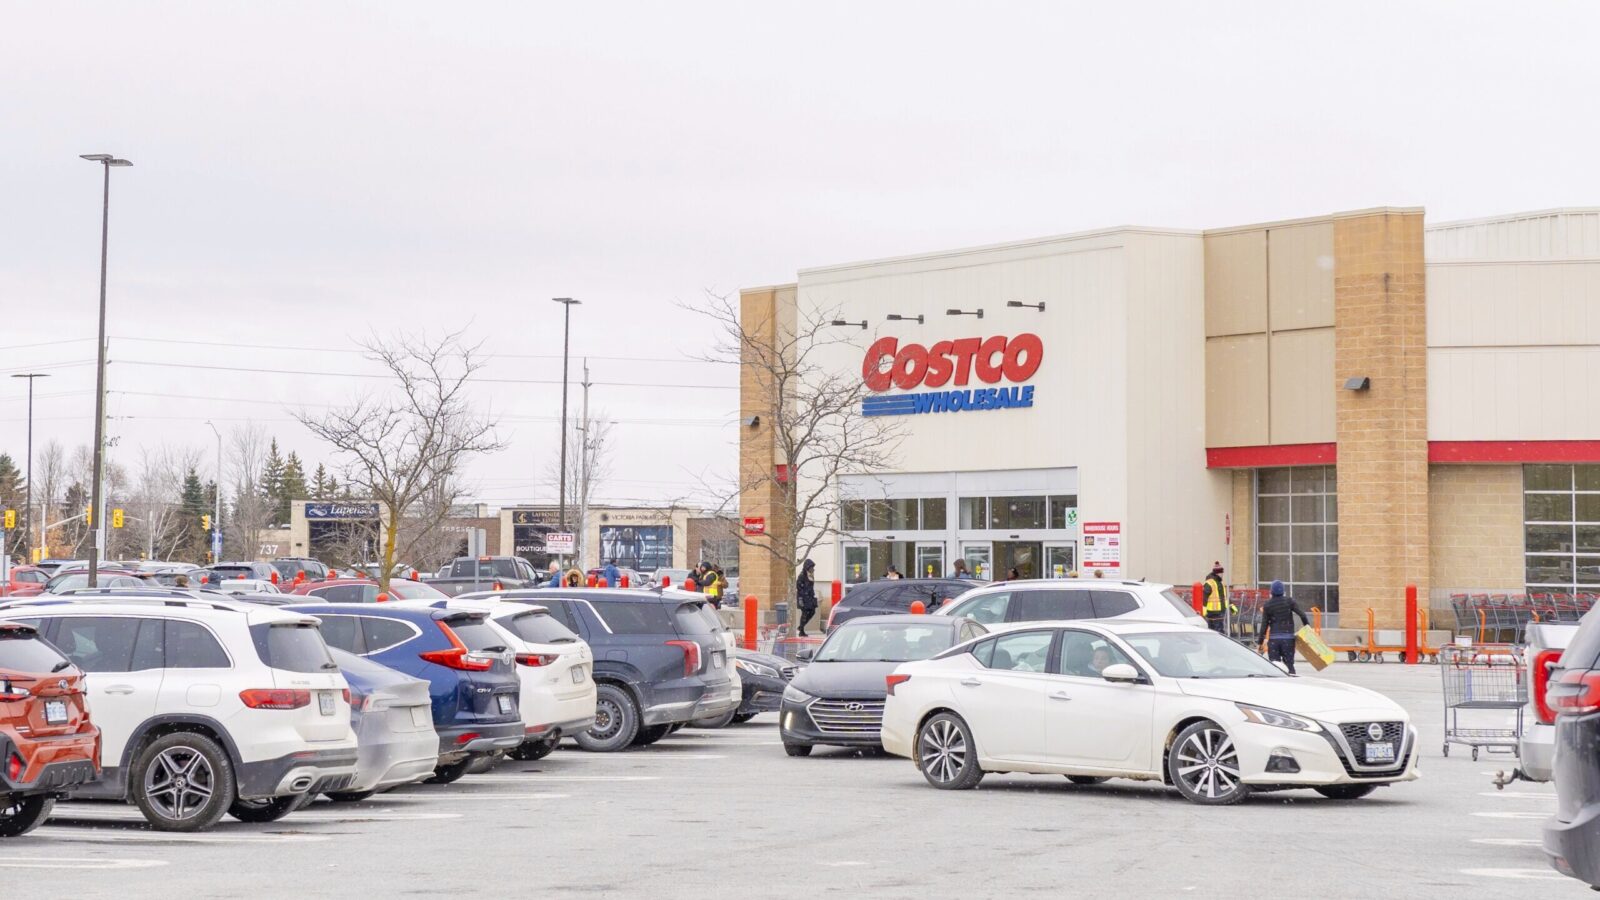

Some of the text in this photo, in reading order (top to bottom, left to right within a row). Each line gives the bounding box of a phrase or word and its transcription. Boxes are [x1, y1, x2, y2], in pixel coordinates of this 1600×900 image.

[862, 333, 1043, 392] COSTCO
[911, 385, 1035, 414] WHOLESALE
[260, 544, 279, 555] 737
